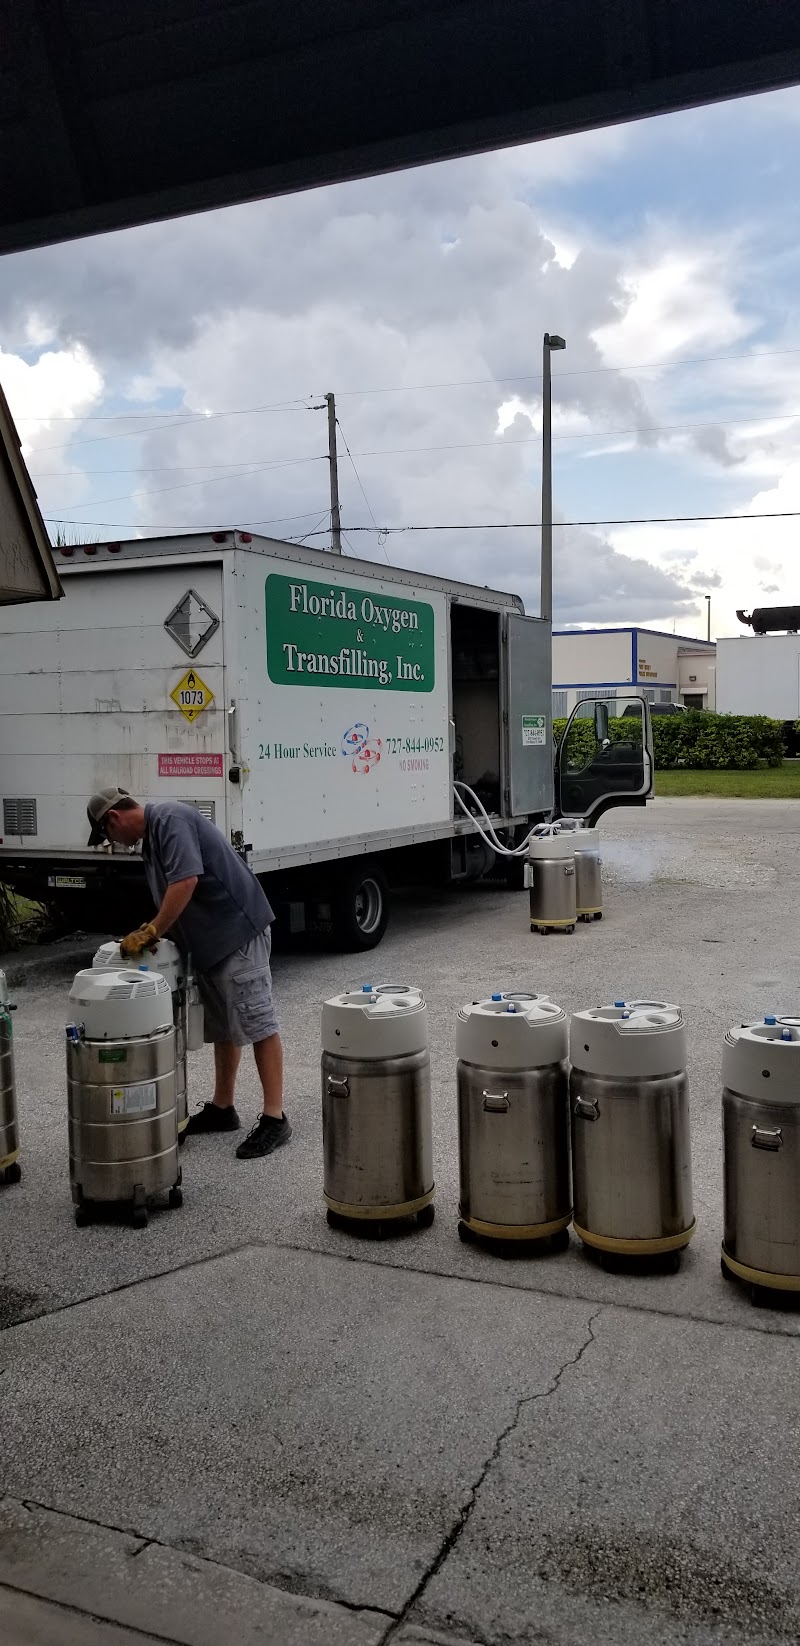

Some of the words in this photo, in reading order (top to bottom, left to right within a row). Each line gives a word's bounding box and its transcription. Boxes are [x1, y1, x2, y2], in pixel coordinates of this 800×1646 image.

[289, 584, 357, 621] Florida
[361, 597, 419, 633] Oxygen
[356, 628, 364, 643] &
[283, 643, 392, 684] Transfilling,
[396, 655, 425, 681] Inc.
[180, 691, 203, 704] 1073
[258, 743, 270, 760] 24
[274, 743, 301, 759] Hour
[303, 742, 337, 758] Service
[386, 737, 444, 755] 727-844-0952
[161, 756, 173, 765] THIS
[173, 756, 195, 765] VEHICLE
[195, 756, 213, 765] STOPS
[213, 756, 220, 765] AT
[399, 759, 407, 772] NO
[407, 758, 430, 771] SMOKING
[159, 766, 169, 774] ALL
[169, 766, 193, 774] RAILROAD
[193, 766, 222, 774] CROSSINGS
